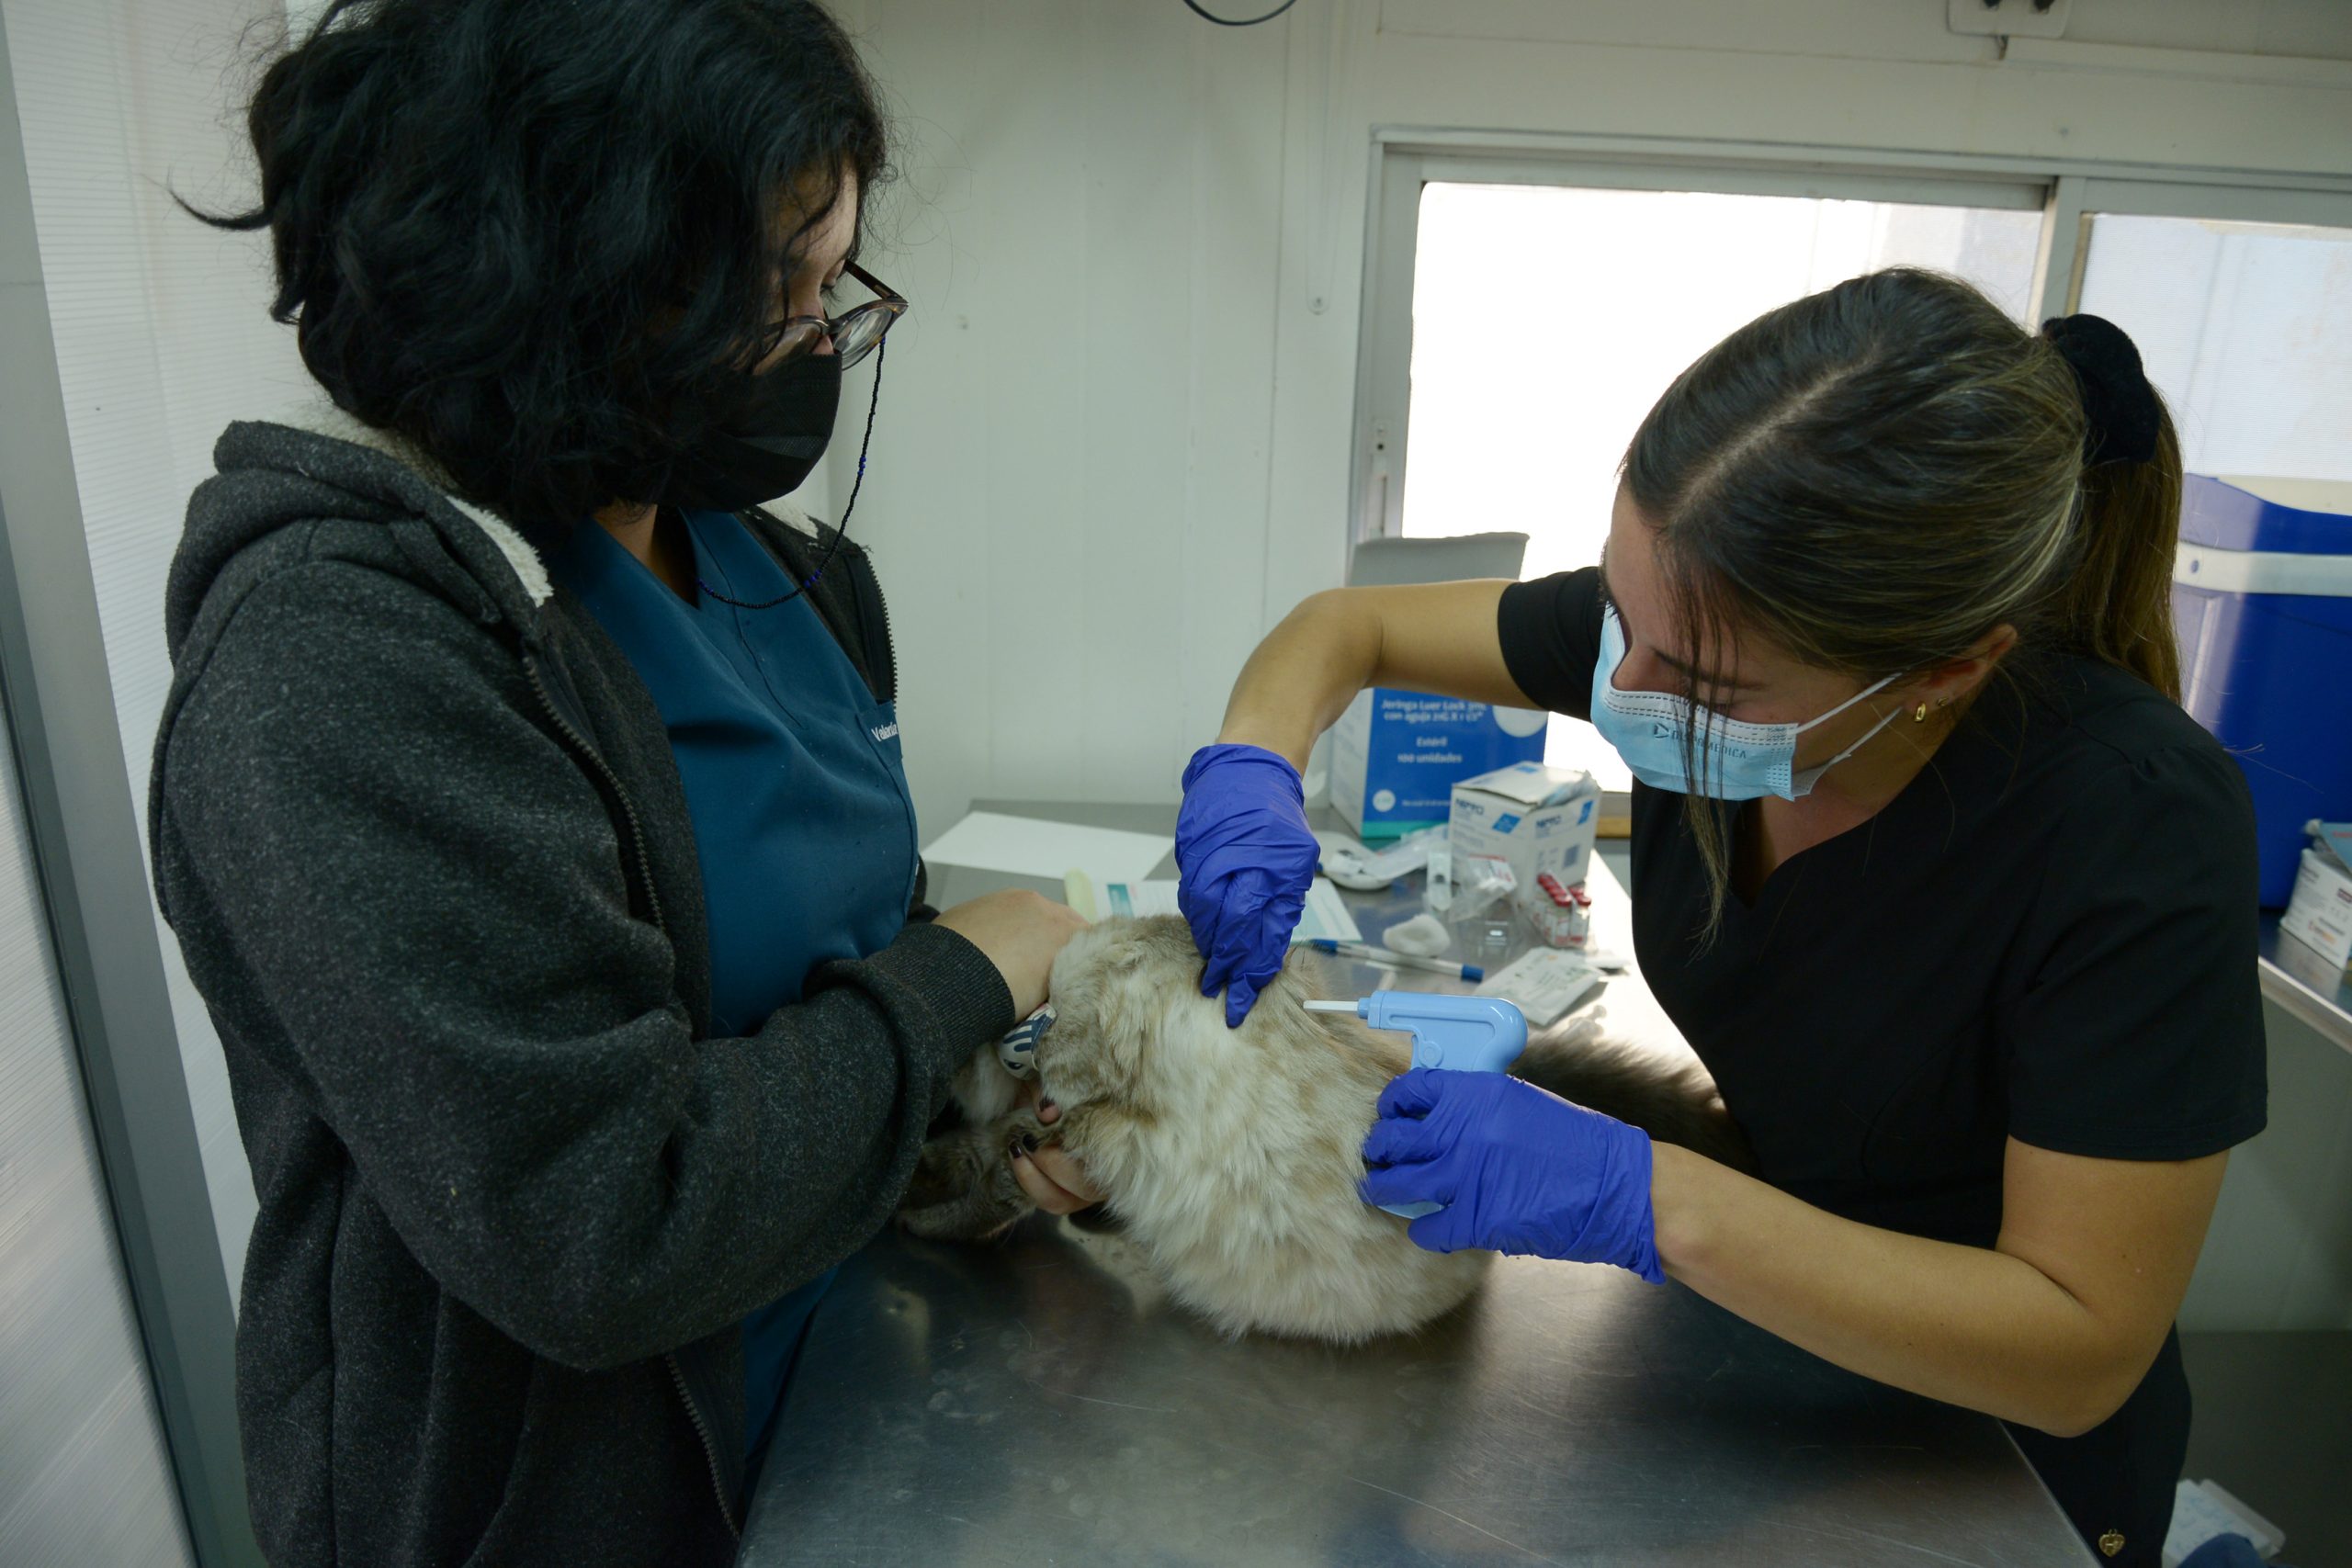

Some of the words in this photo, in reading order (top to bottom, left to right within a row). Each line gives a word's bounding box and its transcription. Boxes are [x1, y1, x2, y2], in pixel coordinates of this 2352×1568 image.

[1382, 699, 1418, 714] Jeringa
[1419, 699, 1442, 711] Luer
[1443, 700, 1465, 711] Lock
[1384, 711, 1403, 721] con
[1405, 711, 1430, 724] aguja
[1417, 753, 1463, 764] unidades
